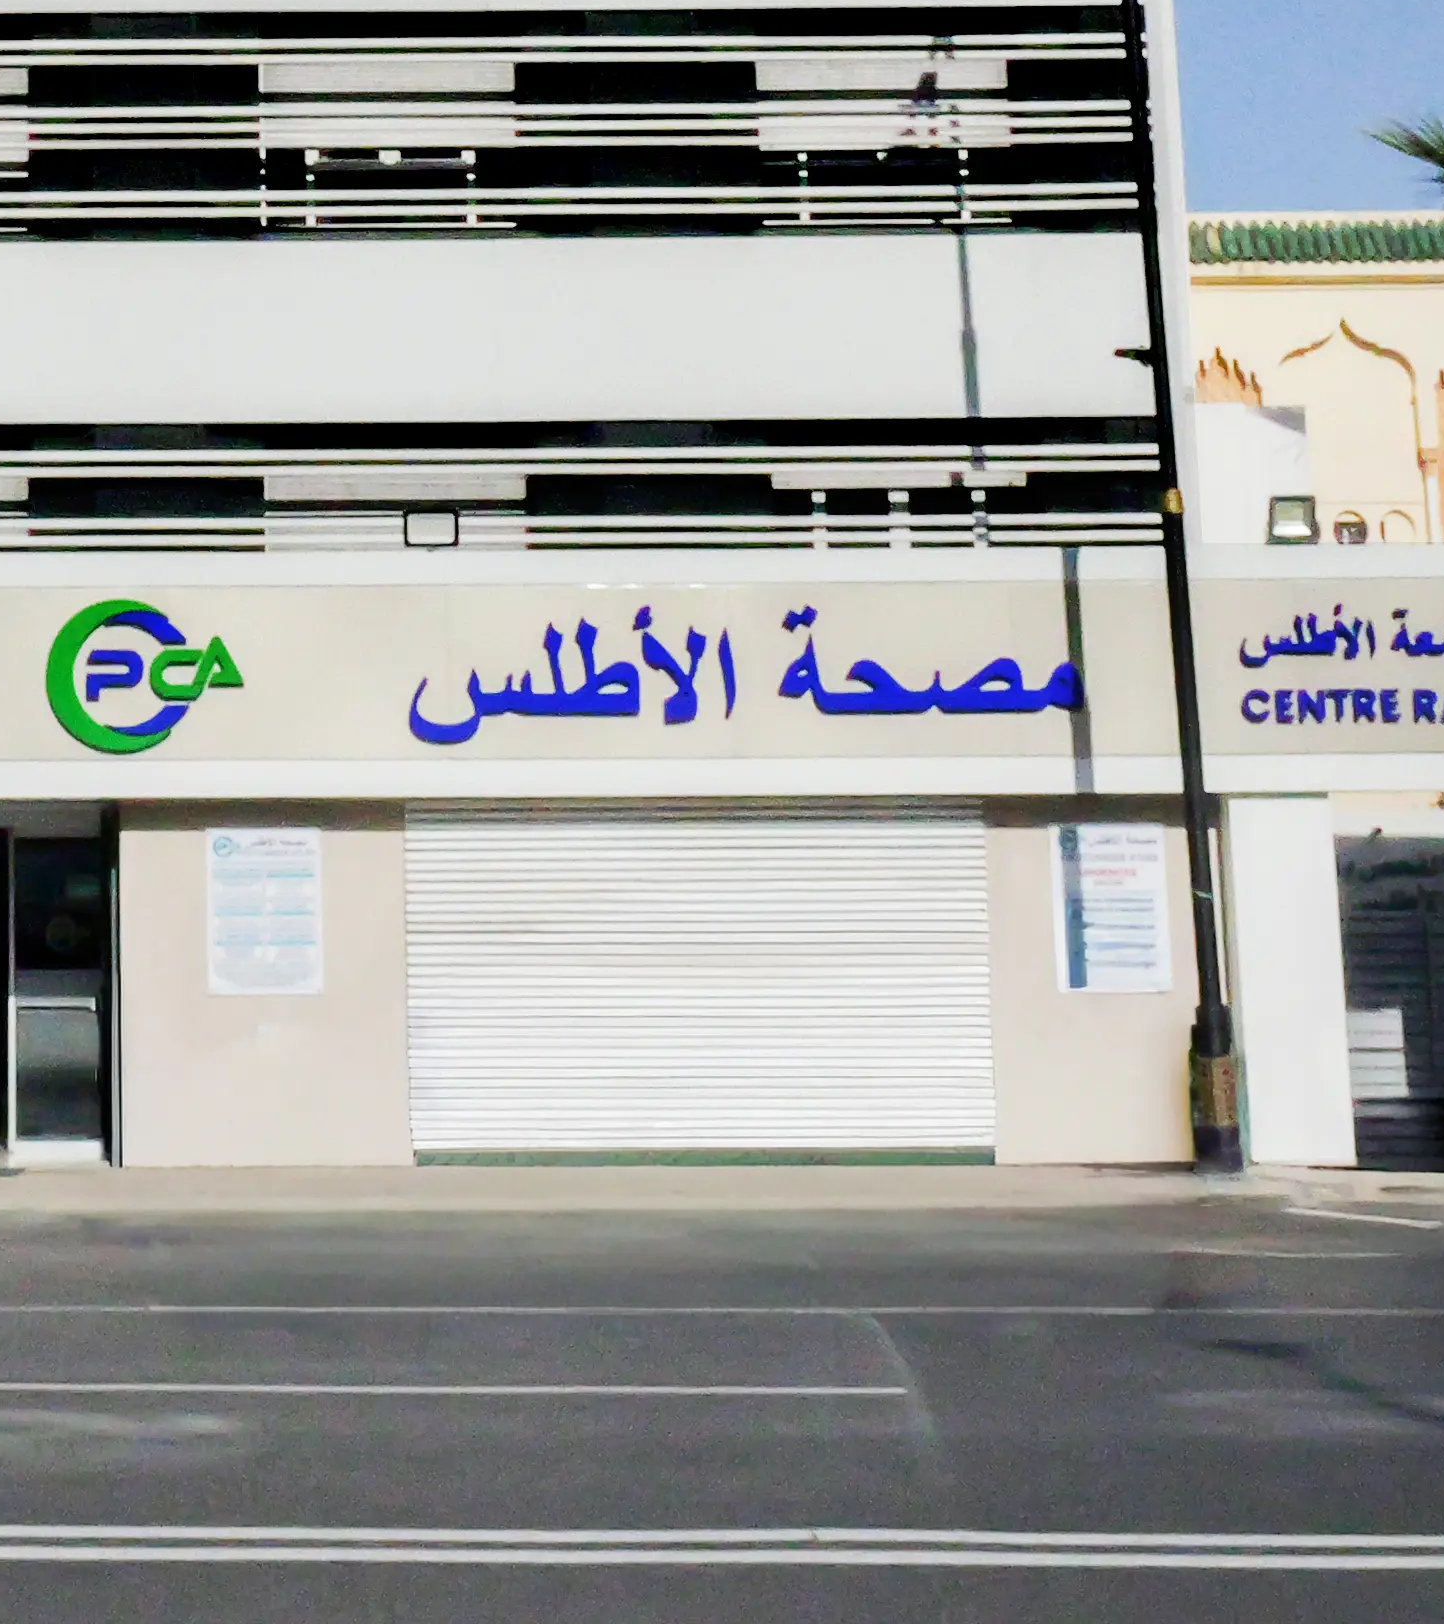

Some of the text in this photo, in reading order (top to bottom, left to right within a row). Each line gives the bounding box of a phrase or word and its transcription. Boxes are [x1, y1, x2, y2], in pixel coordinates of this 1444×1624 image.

[1239, 604, 1376, 668] الأطلس
[409, 604, 1085, 745] مصحة الأطلس
[1241, 689, 1401, 724] CENTRE
